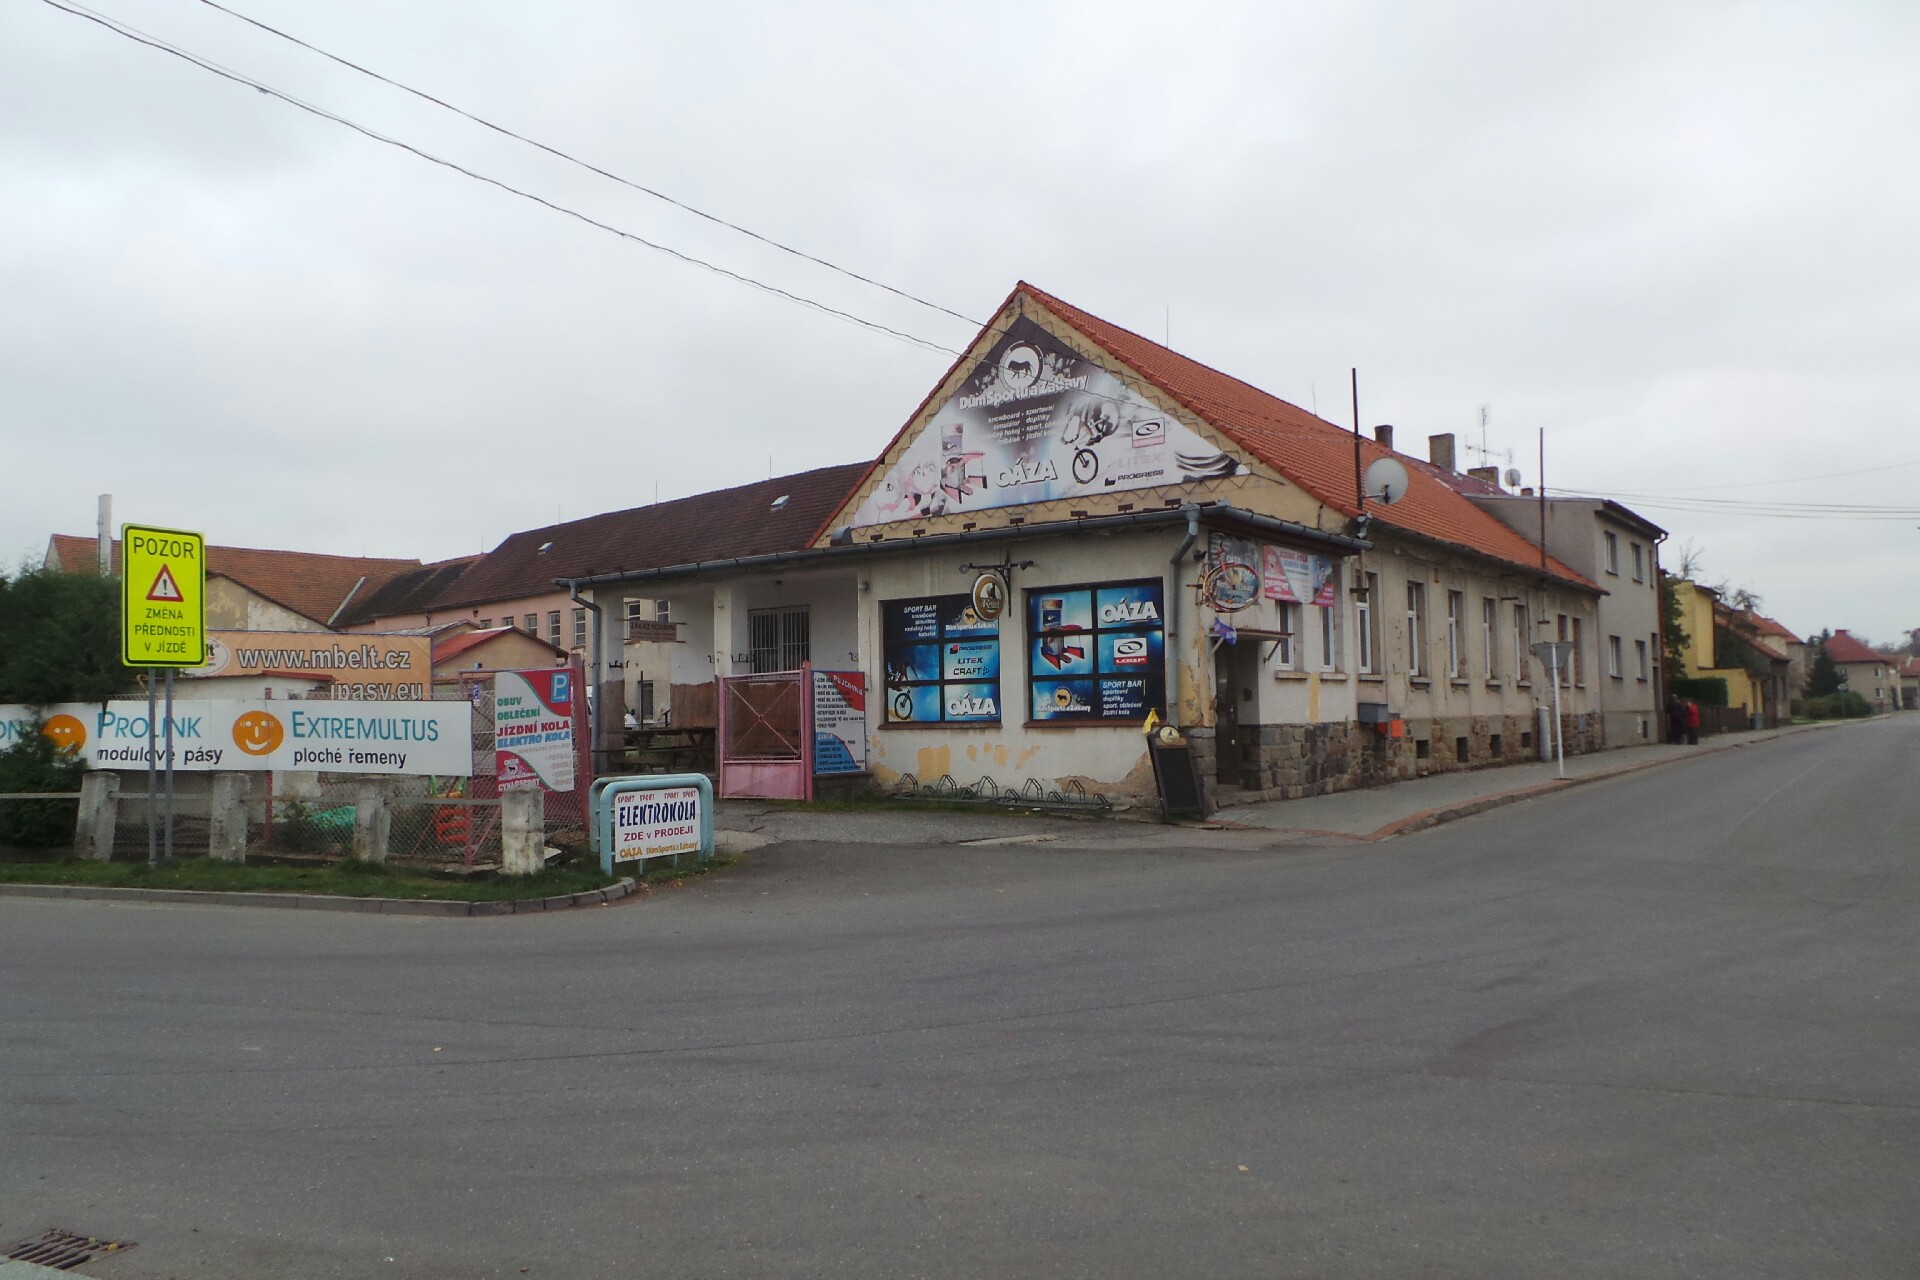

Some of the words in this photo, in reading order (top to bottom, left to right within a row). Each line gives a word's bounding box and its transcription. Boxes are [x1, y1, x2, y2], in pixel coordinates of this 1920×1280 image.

[997, 457, 1058, 488] OÁZA
[1117, 469, 1165, 482] PROGRESS
[133, 536, 195, 559] POZOR
[145, 607, 184, 620] ZMĚNA
[904, 606, 923, 614] SPORT
[924, 604, 937, 612] BAR
[1102, 597, 1159, 623] OÁZA
[134, 623, 195, 637] PŘEDNOSTI
[144, 642, 151, 653] V
[156, 639, 187, 653] JÍZDĚ
[237, 644, 411, 669] www.mbelt.cz
[953, 668, 983, 676] CRAFT
[1102, 680, 1126, 689] SPORT
[497, 696, 522, 707] OBUV
[947, 692, 997, 717] OÁZA
[497, 706, 540, 720] OBLEČENÍ
[97, 711, 203, 739] PROINK
[292, 711, 439, 742] EXTREMULTUS
[496, 720, 538, 737] JÍZDNÍ
[541, 720, 570, 733] KOLA
[497, 734, 543, 749] ELEKTRO
[544, 731, 571, 743] KOLA
[184, 746, 223, 766] pásy
[294, 747, 342, 766] ploché
[349, 748, 407, 768] řemeny
[617, 795, 635, 804] SPORT
[639, 794, 655, 802] SPORT
[664, 791, 680, 799] SPORT
[682, 790, 697, 798] SPORT
[619, 800, 696, 828] ELEKTROKOLA
[624, 831, 644, 842] ZDE
[654, 826, 694, 838] PRODEJI
[620, 845, 643, 858] OÁZA
